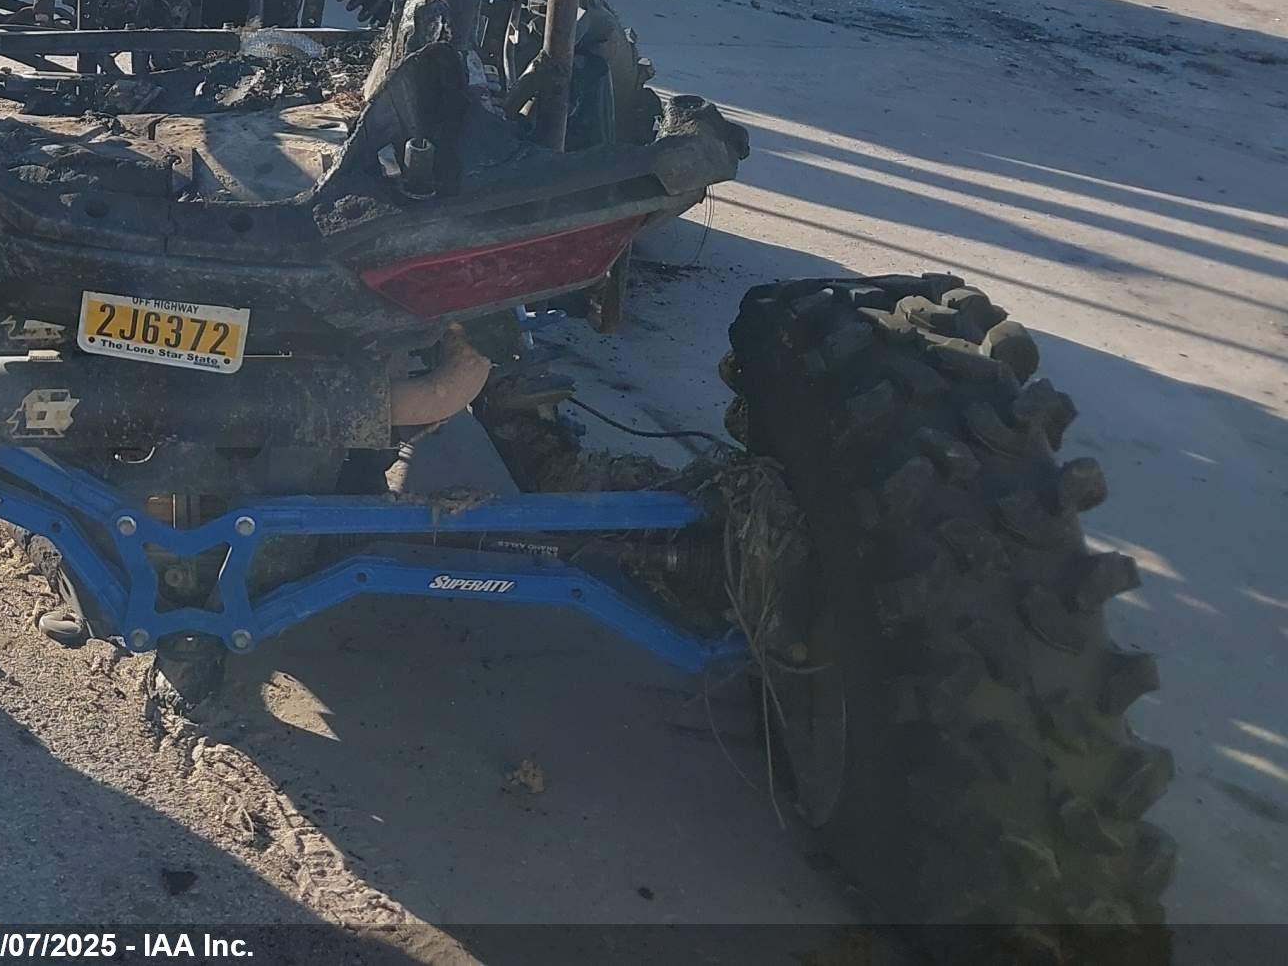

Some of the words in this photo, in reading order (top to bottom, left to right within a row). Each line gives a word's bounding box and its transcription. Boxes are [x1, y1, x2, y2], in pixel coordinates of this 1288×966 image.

[132, 297, 150, 307] OFF
[153, 299, 199, 314] HIGHWAY
[95, 303, 230, 356] 2J6372
[100, 338, 122, 350] The
[126, 341, 155, 355] Lone
[158, 348, 183, 362] Star
[187, 353, 218, 365] State
